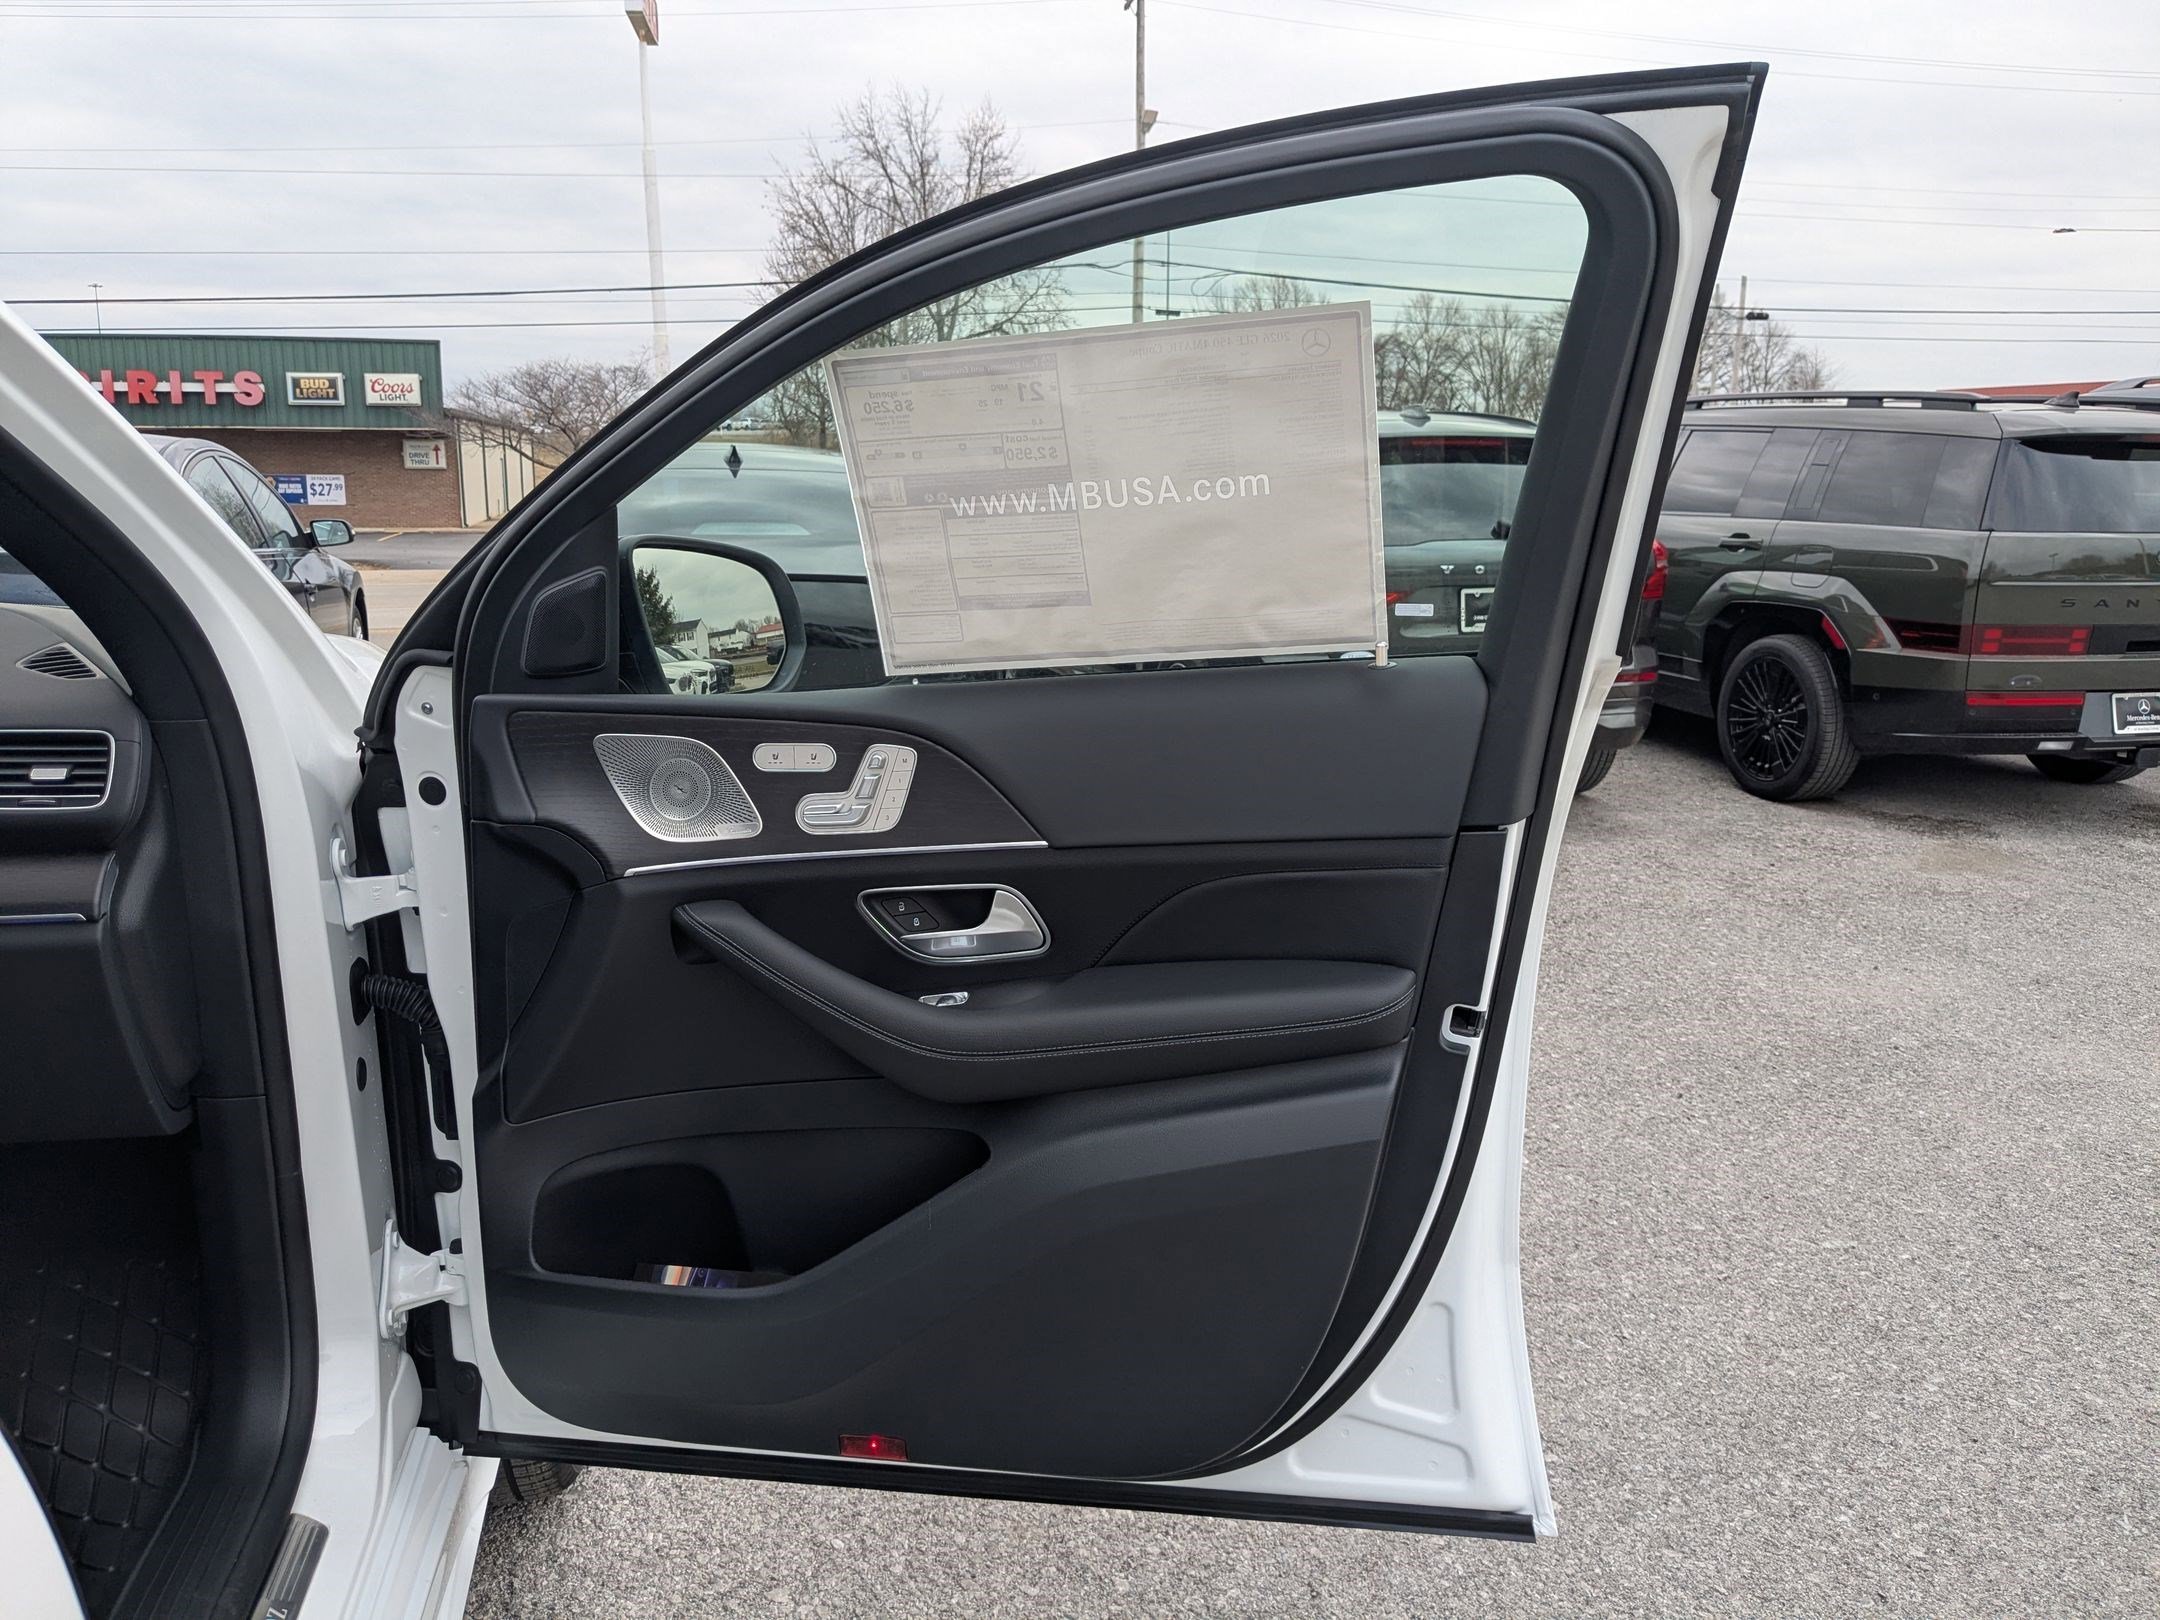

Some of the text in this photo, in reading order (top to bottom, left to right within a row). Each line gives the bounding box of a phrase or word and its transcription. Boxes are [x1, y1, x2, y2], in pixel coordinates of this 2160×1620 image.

[80, 369, 264, 406] IRITS
[300, 378, 330, 389] BUD
[370, 377, 415, 393] Coors
[295, 388, 335, 398] LIGHT
[379, 393, 408, 401] LIGHT
[309, 482, 344, 498] $27.99
[950, 472, 1271, 518] www.MBUSA.com
[2060, 598, 2160, 608] SAN
